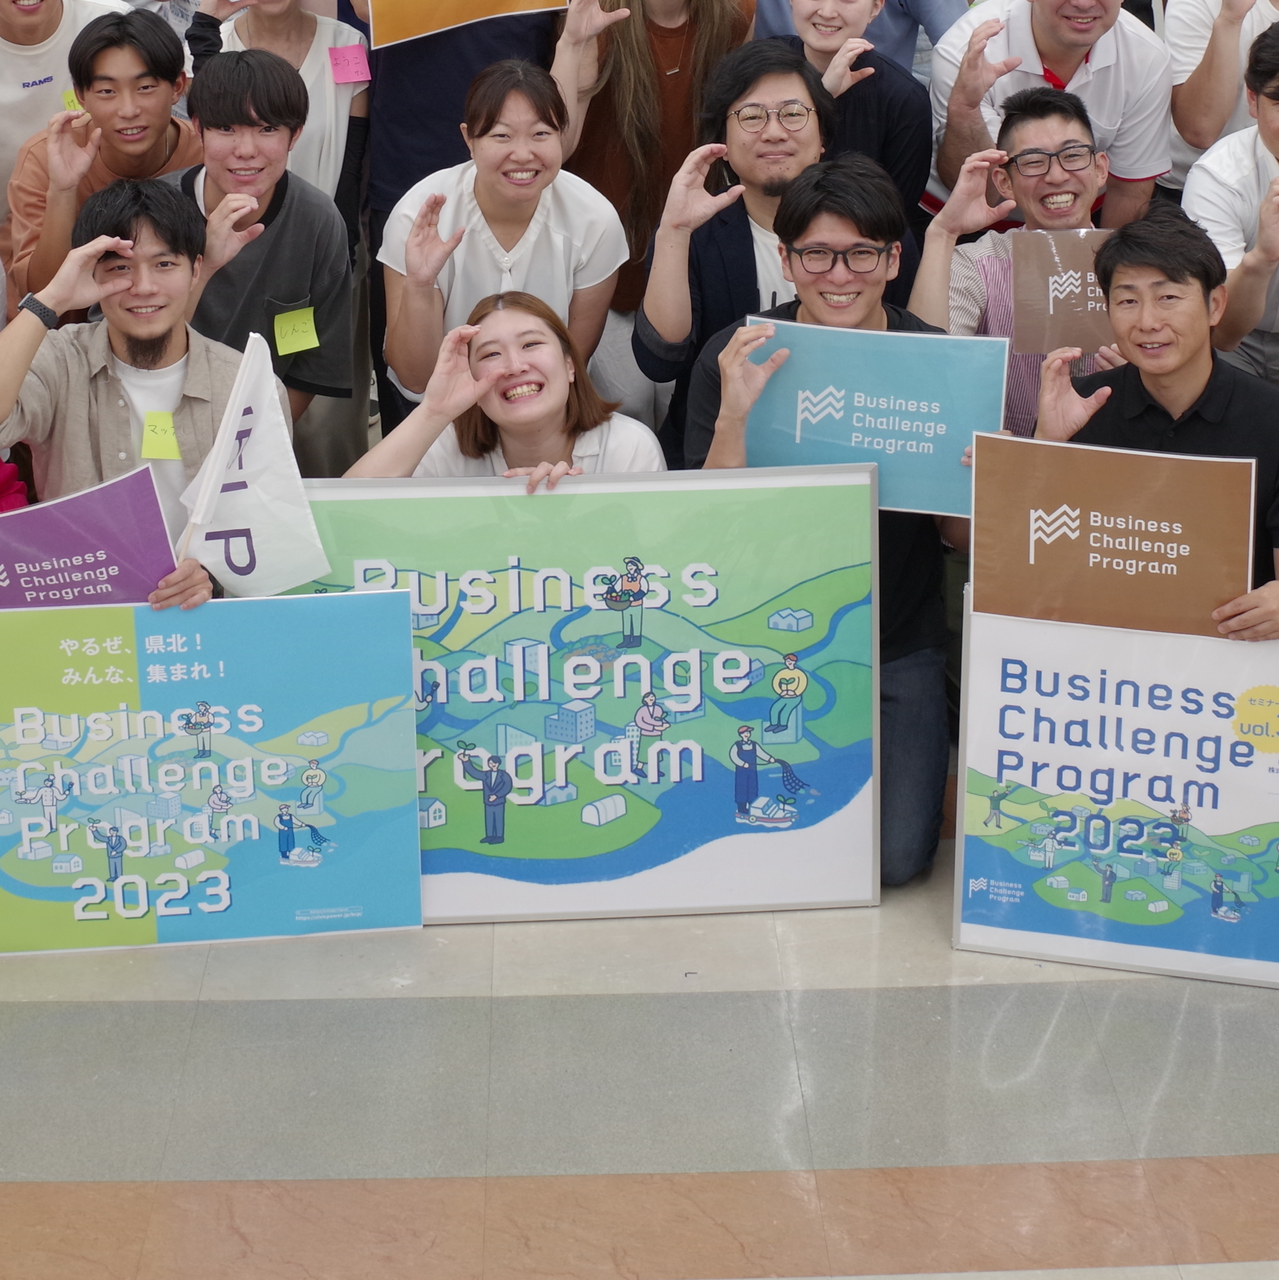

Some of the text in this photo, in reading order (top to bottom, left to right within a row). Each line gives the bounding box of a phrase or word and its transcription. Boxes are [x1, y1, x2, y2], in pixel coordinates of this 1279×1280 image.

[333, 56, 361, 67] ようこ
[22, 75, 54, 89] RAMS
[853, 391, 941, 414] Business
[852, 412, 947, 437] Challenge
[851, 432, 934, 454] Program
[1089, 511, 1183, 534] Business
[1089, 532, 1190, 558] Challenge
[14, 549, 108, 574] Business
[1088, 552, 1177, 575] Program
[20, 563, 120, 587] Challenge
[24, 582, 112, 601] Program
[412, 643, 754, 714] hallenge
[1000, 657, 1236, 719] Business
[13, 702, 265, 746] Business
[998, 704, 1256, 774] Challenge
[16, 755, 290, 799] Challenge
[416, 738, 706, 806] rogram
[996, 749, 1220, 810] Program
[19, 811, 262, 858] Program
[1050, 809, 1182, 860] 2023
[72, 868, 233, 920] 2023
[989, 886, 1025, 897] Challenge
[990, 879, 1022, 889] Business
[989, 893, 1020, 903] Program
